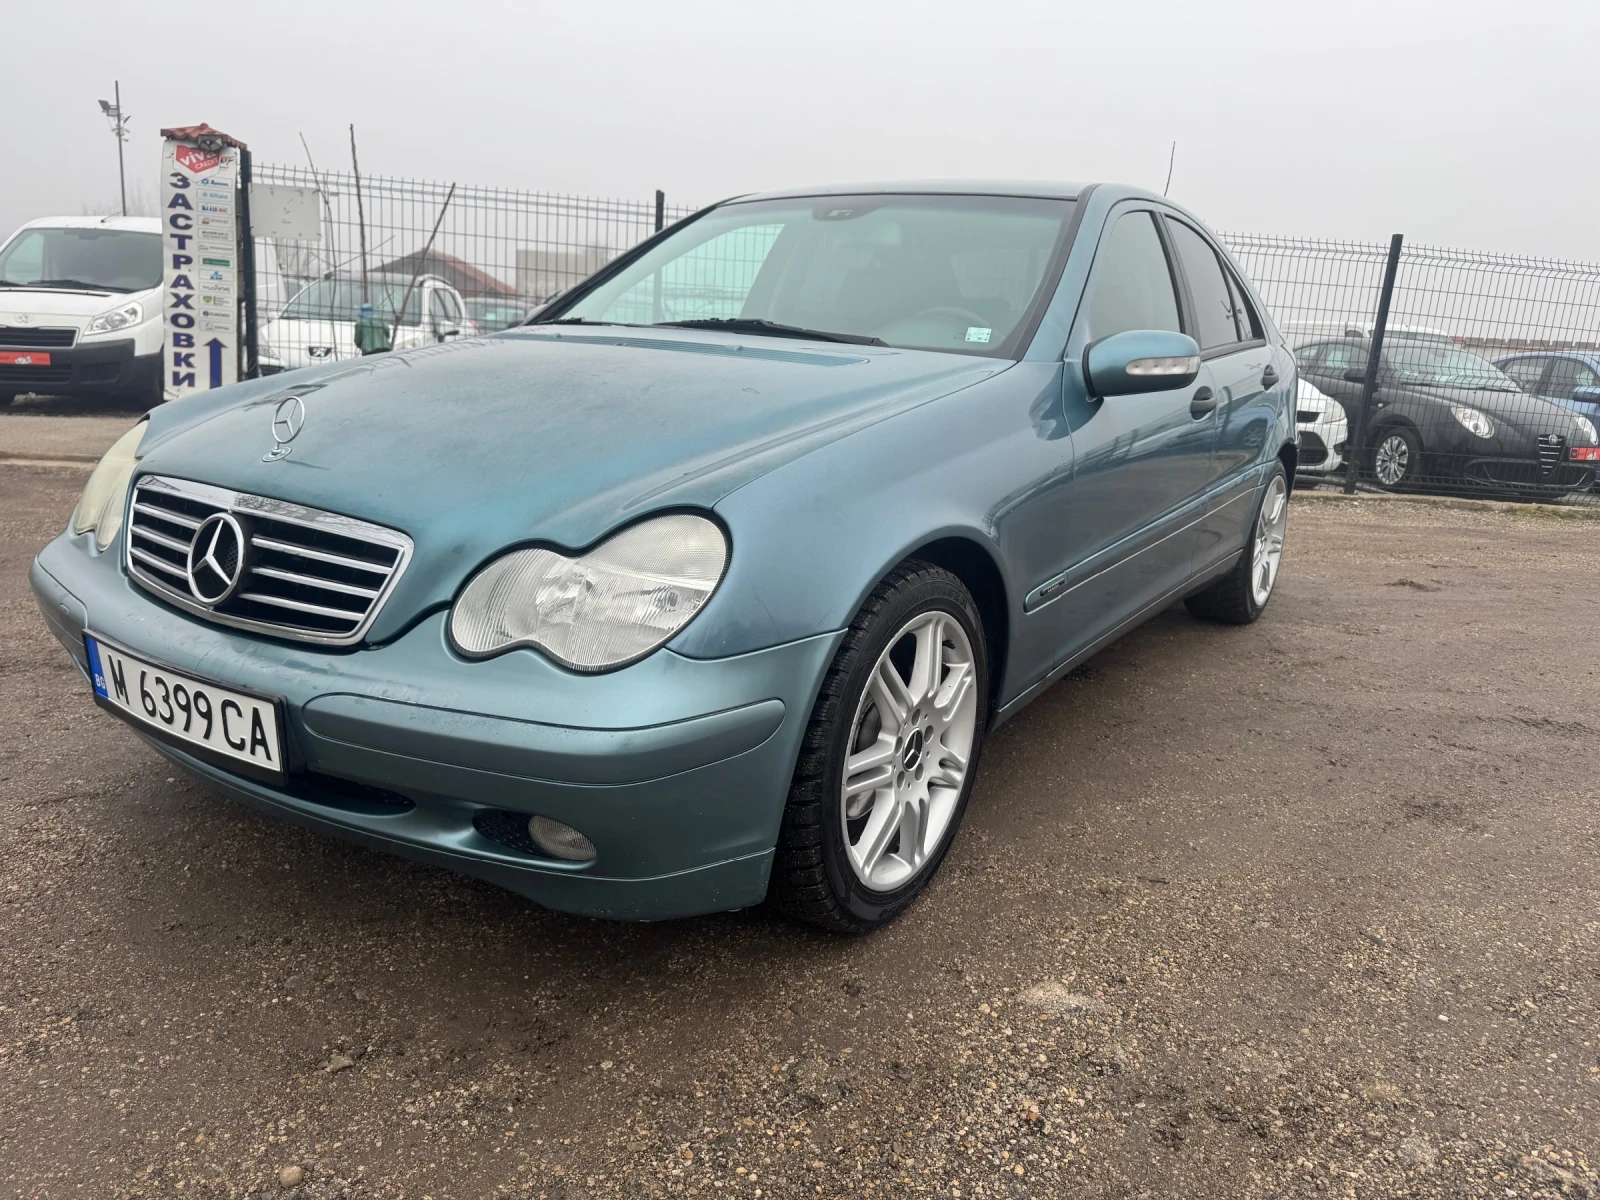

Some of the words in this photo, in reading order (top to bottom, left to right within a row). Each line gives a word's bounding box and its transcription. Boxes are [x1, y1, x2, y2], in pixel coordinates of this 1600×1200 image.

[195, 157, 218, 169] CREDIT
[167, 172, 196, 387] ЗАСТРАХОВКИ
[95, 673, 106, 690] BG
[108, 653, 130, 705] M
[140, 669, 213, 740] 6399
[221, 699, 272, 761] CA
